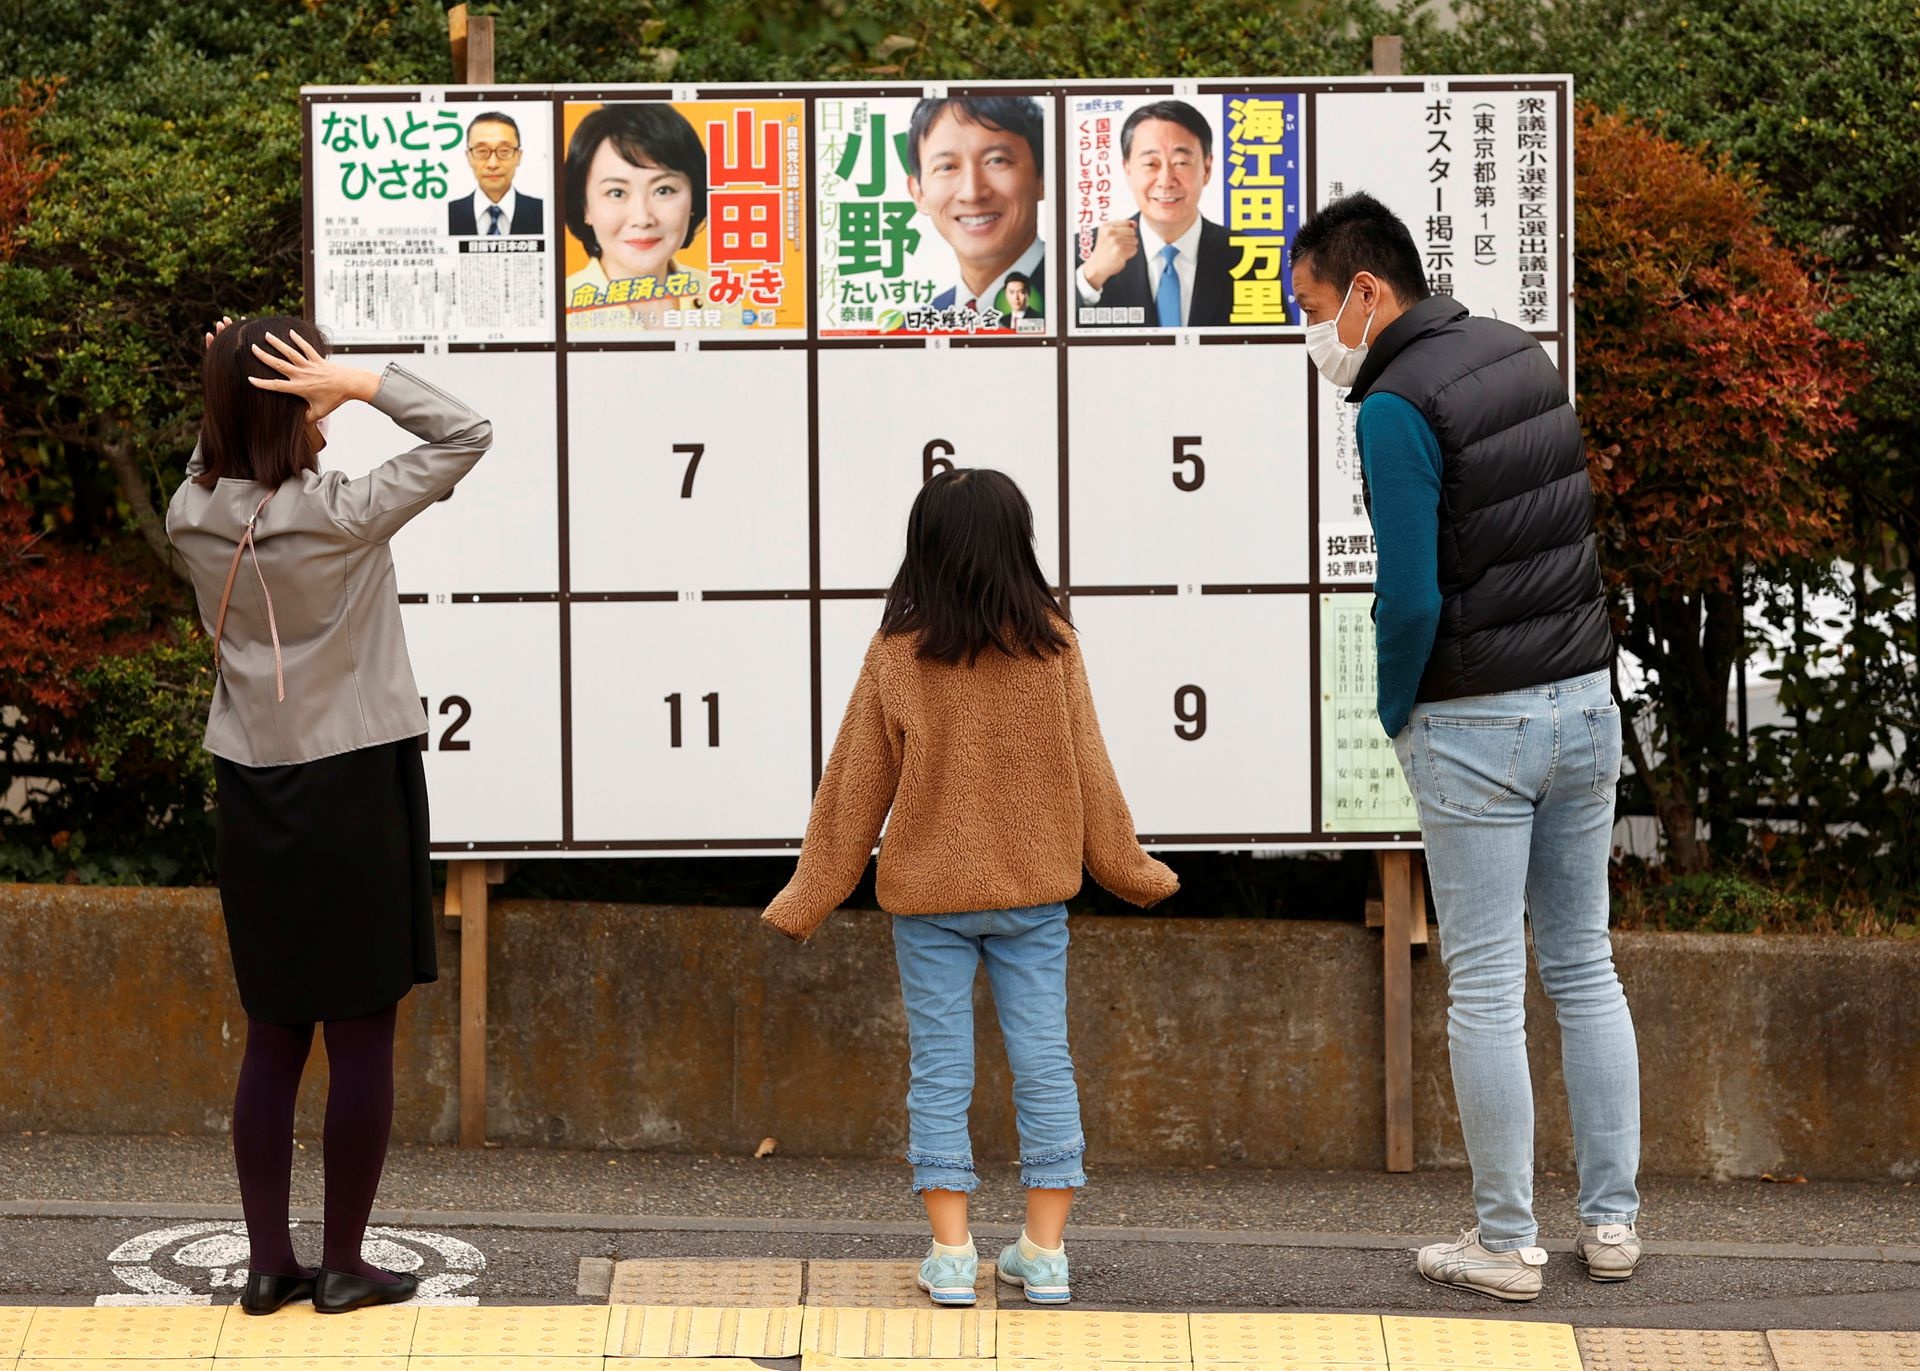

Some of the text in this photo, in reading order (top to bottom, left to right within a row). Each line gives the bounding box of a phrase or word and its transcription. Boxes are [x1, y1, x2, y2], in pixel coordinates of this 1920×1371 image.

[1430, 82, 1441, 92] 15
[321, 110, 464, 152] ないとう
[340, 159, 449, 200] ひさお
[708, 111, 781, 264] 山田
[835, 114, 921, 278] 小野
[1078, 120, 1093, 259] くらしを守る力になる
[1096, 118, 1111, 221] 国民のいのちと
[1425, 97, 1454, 296] ポスター掲示場
[1228, 98, 1286, 323] 海江田万里
[1517, 98, 1548, 324] 衆議院小選挙区選出議員選挙
[571, 272, 699, 308] 命と経済を守る
[709, 268, 782, 304] みき
[841, 279, 936, 304] たいすけ
[672, 443, 705, 498] 7
[1172, 436, 1205, 492] 5
[1327, 561, 1377, 576] 投票時
[436, 594, 446, 604] 12
[664, 692, 720, 748] 11
[1174, 684, 1207, 741] 9
